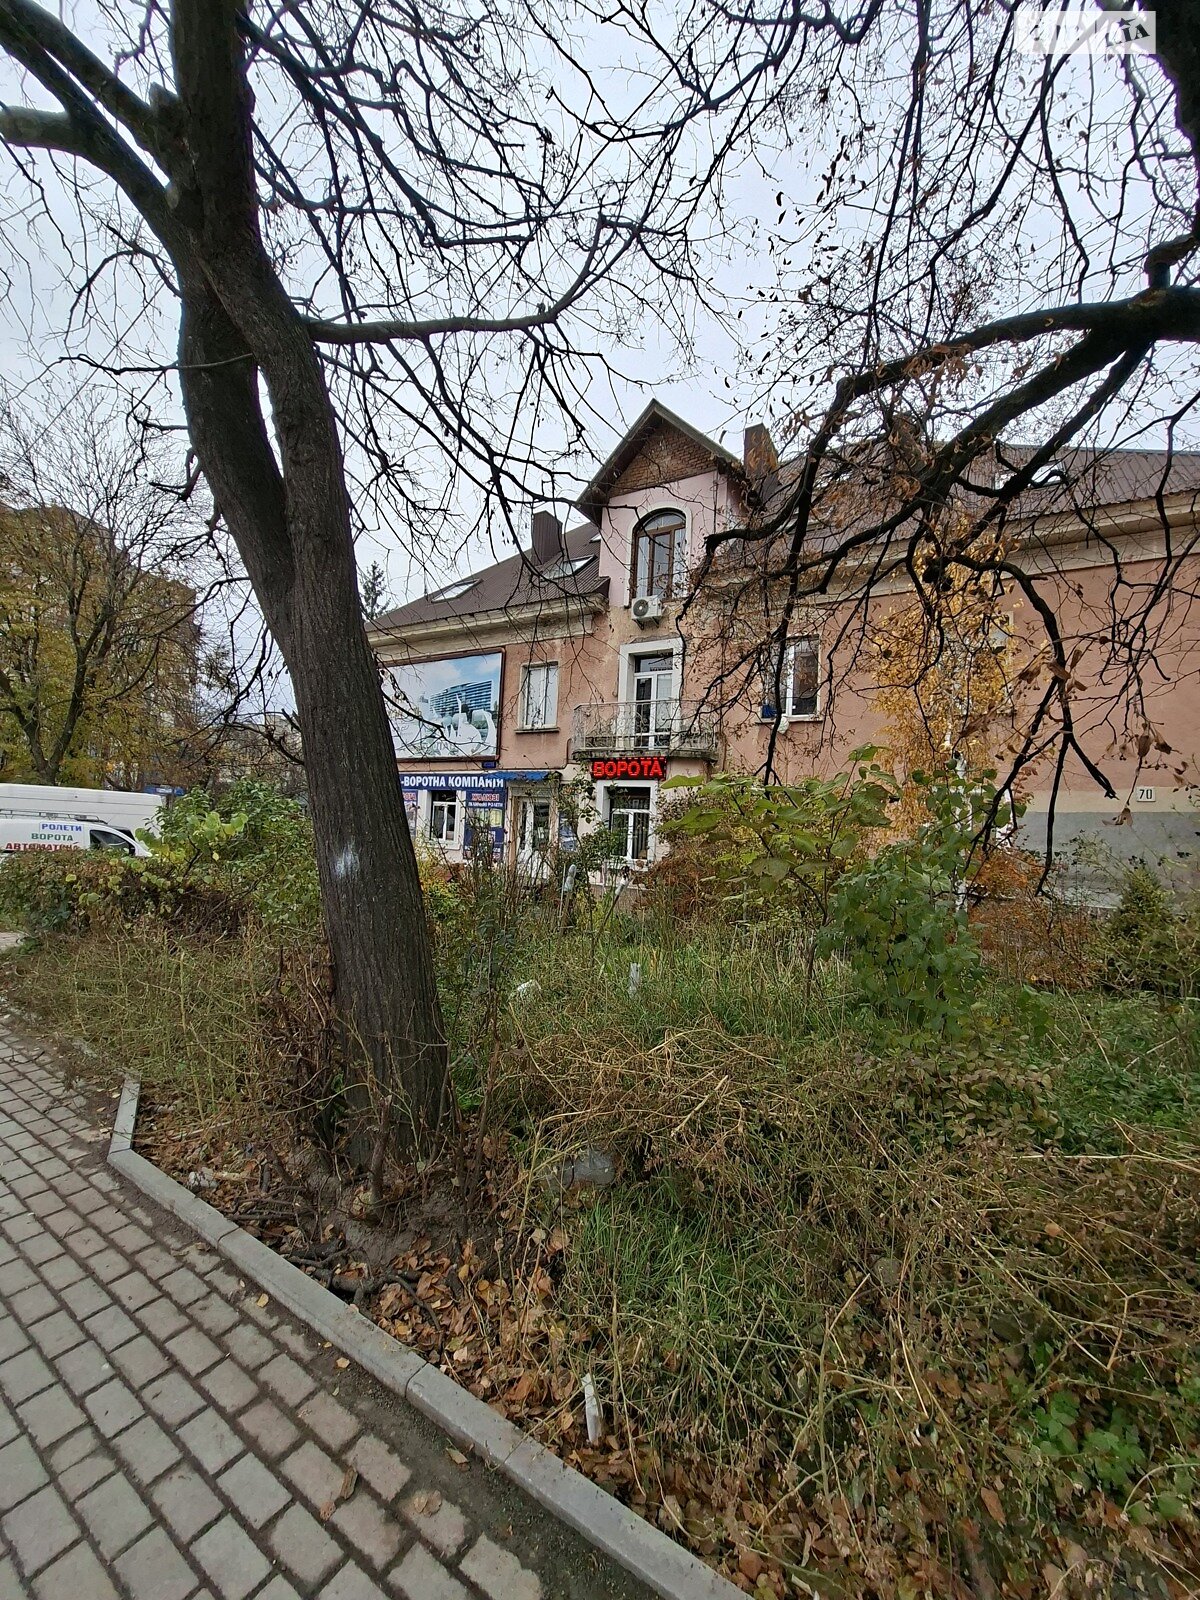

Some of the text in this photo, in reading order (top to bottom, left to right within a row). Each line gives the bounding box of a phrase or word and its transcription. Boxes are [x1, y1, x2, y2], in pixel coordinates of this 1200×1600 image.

[593, 760, 663, 776] ВОРОТА
[1139, 789, 1153, 799] 70
[41, 823, 82, 832] РОЛЕТИ
[31, 833, 73, 841] ВОРОТА
